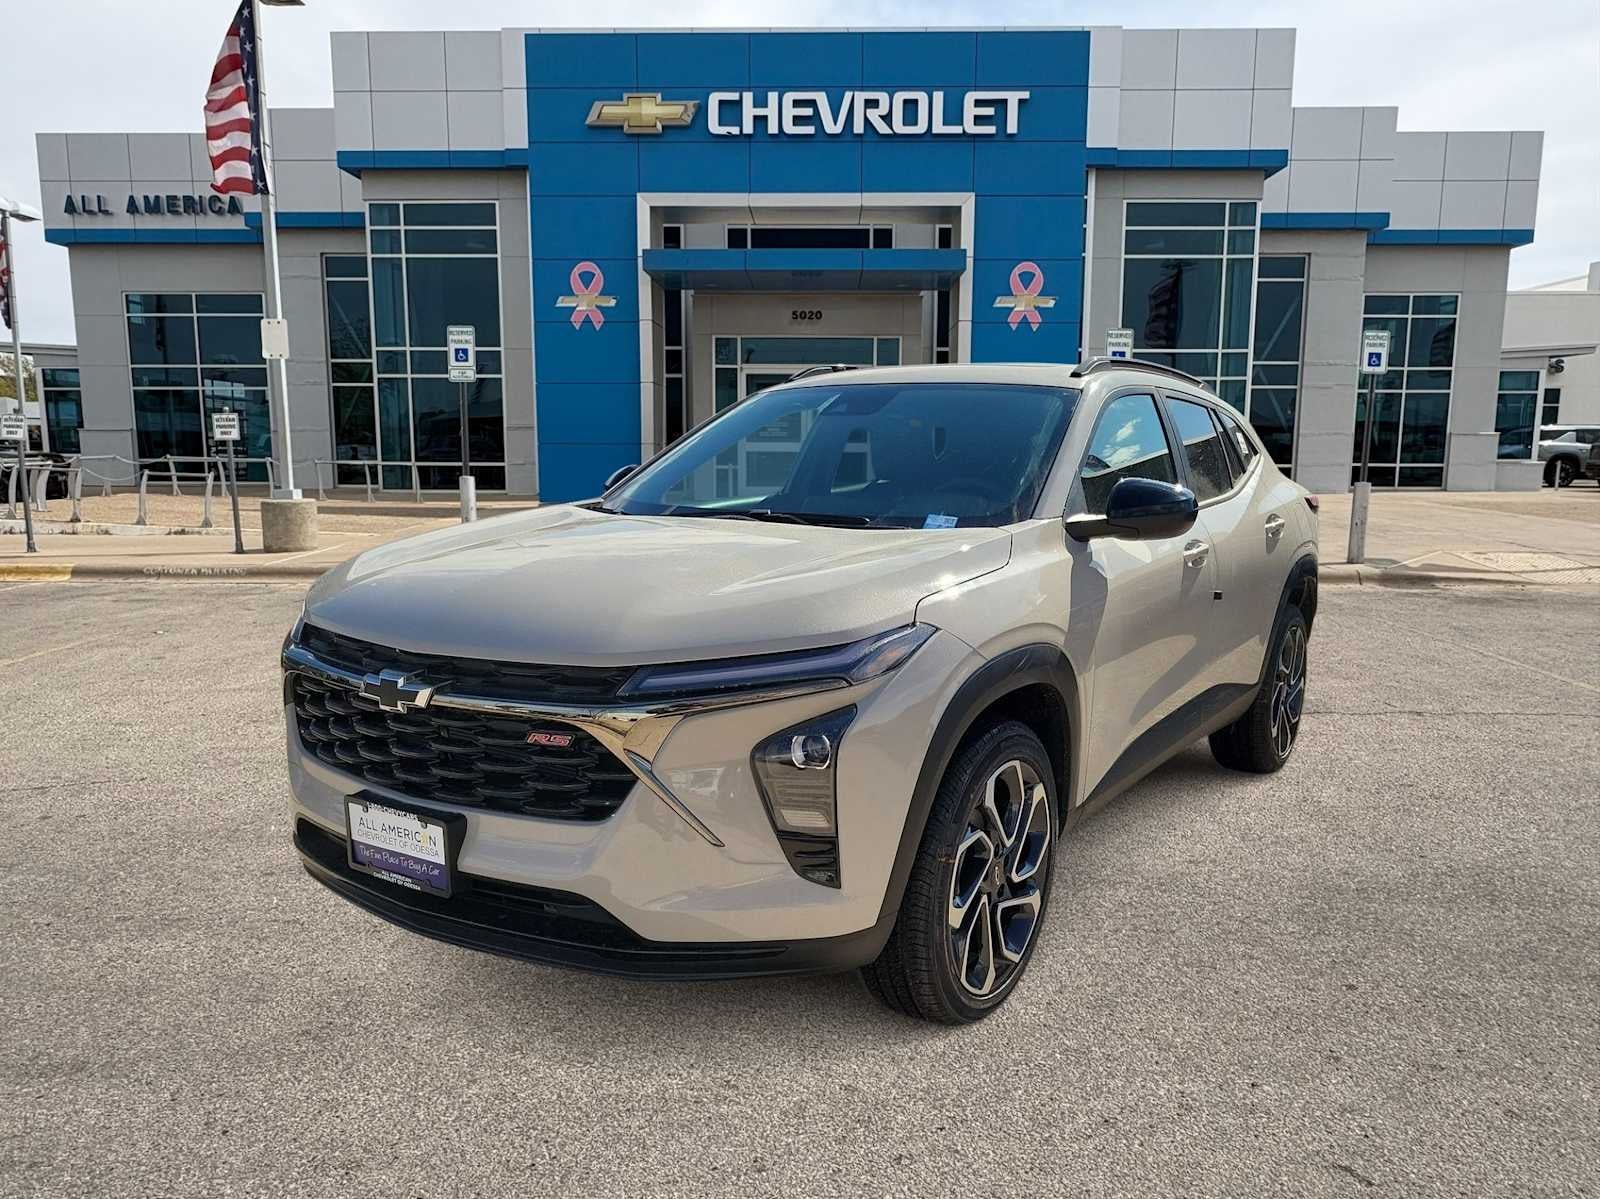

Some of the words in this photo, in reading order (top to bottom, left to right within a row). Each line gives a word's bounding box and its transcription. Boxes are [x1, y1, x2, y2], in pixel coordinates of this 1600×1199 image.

[707, 91, 1031, 135] CHEVROLET
[64, 194, 112, 215] ALL
[791, 309, 823, 320] 5020
[527, 732, 572, 747] RS
[359, 817, 377, 831] ALL
[357, 829, 397, 847] CHEVROLET
[398, 839, 410, 849] OF
[410, 842, 440, 857] ODESSA
[382, 851, 399, 865] Place
[399, 856, 409, 867] To
[408, 860, 421, 873] Buy
[421, 863, 429, 873] A
